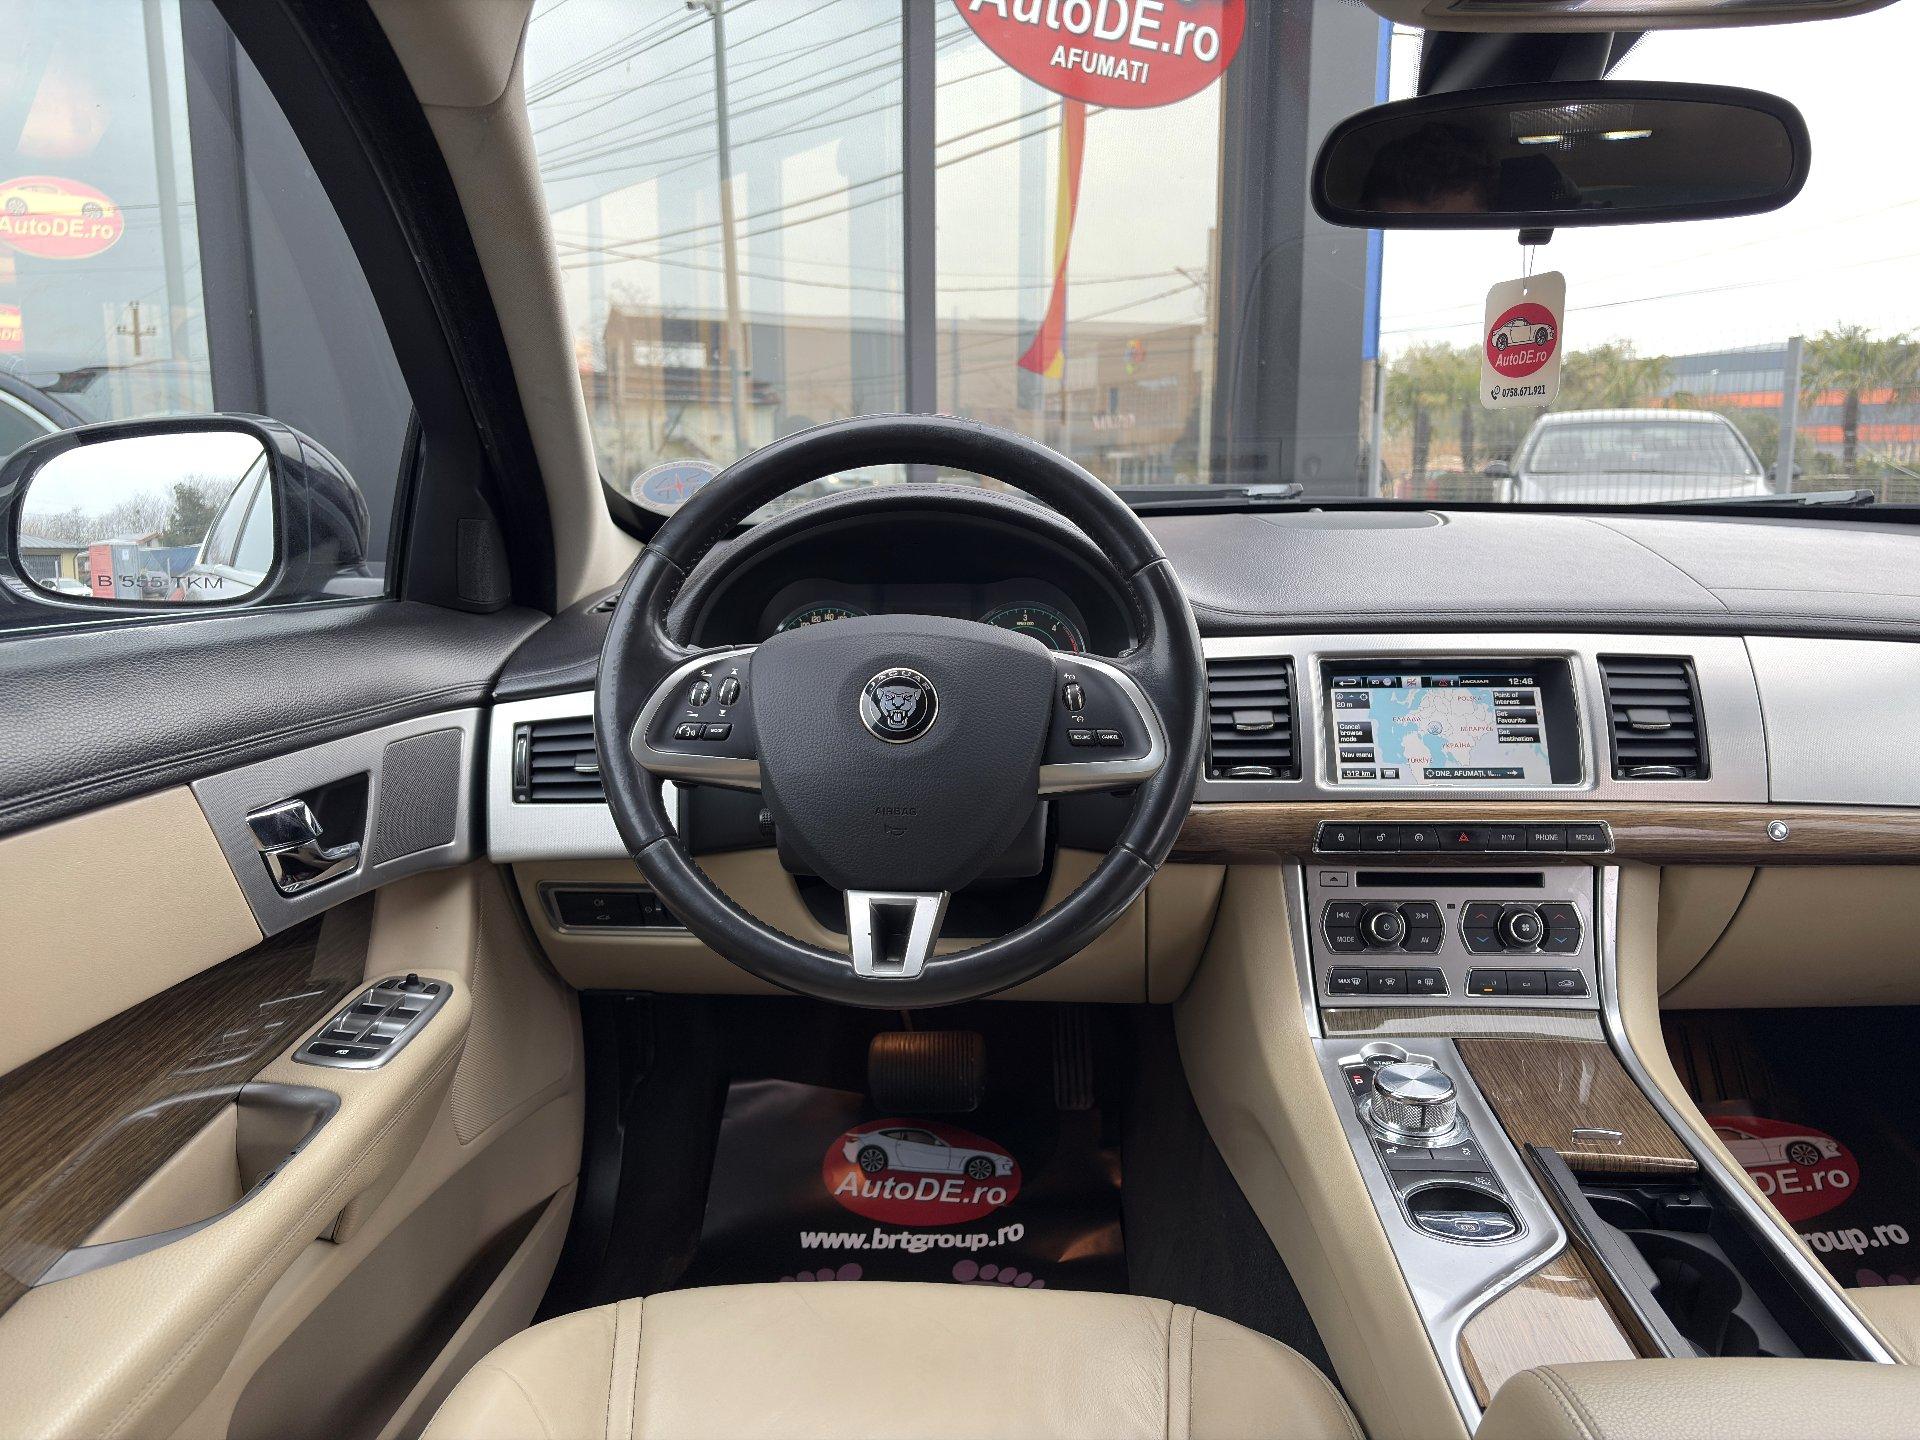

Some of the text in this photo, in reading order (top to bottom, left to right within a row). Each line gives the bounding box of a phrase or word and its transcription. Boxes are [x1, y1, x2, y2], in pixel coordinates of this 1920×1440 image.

[1050, 45, 1150, 84] AFUMATI
[0, 215, 115, 241] AutoDE.ro
[1495, 349, 1547, 367] AutoDE.ro
[1501, 384, 1546, 398] 0758.671.921
[97, 575, 112, 587] B
[171, 576, 223, 589] TKM
[869, 670, 931, 691] JAGUAR
[874, 806, 917, 816] AIRBAG
[834, 1171, 1008, 1206] AutoDE.ro
[800, 1222, 1025, 1254] www.brtgroup.ro
